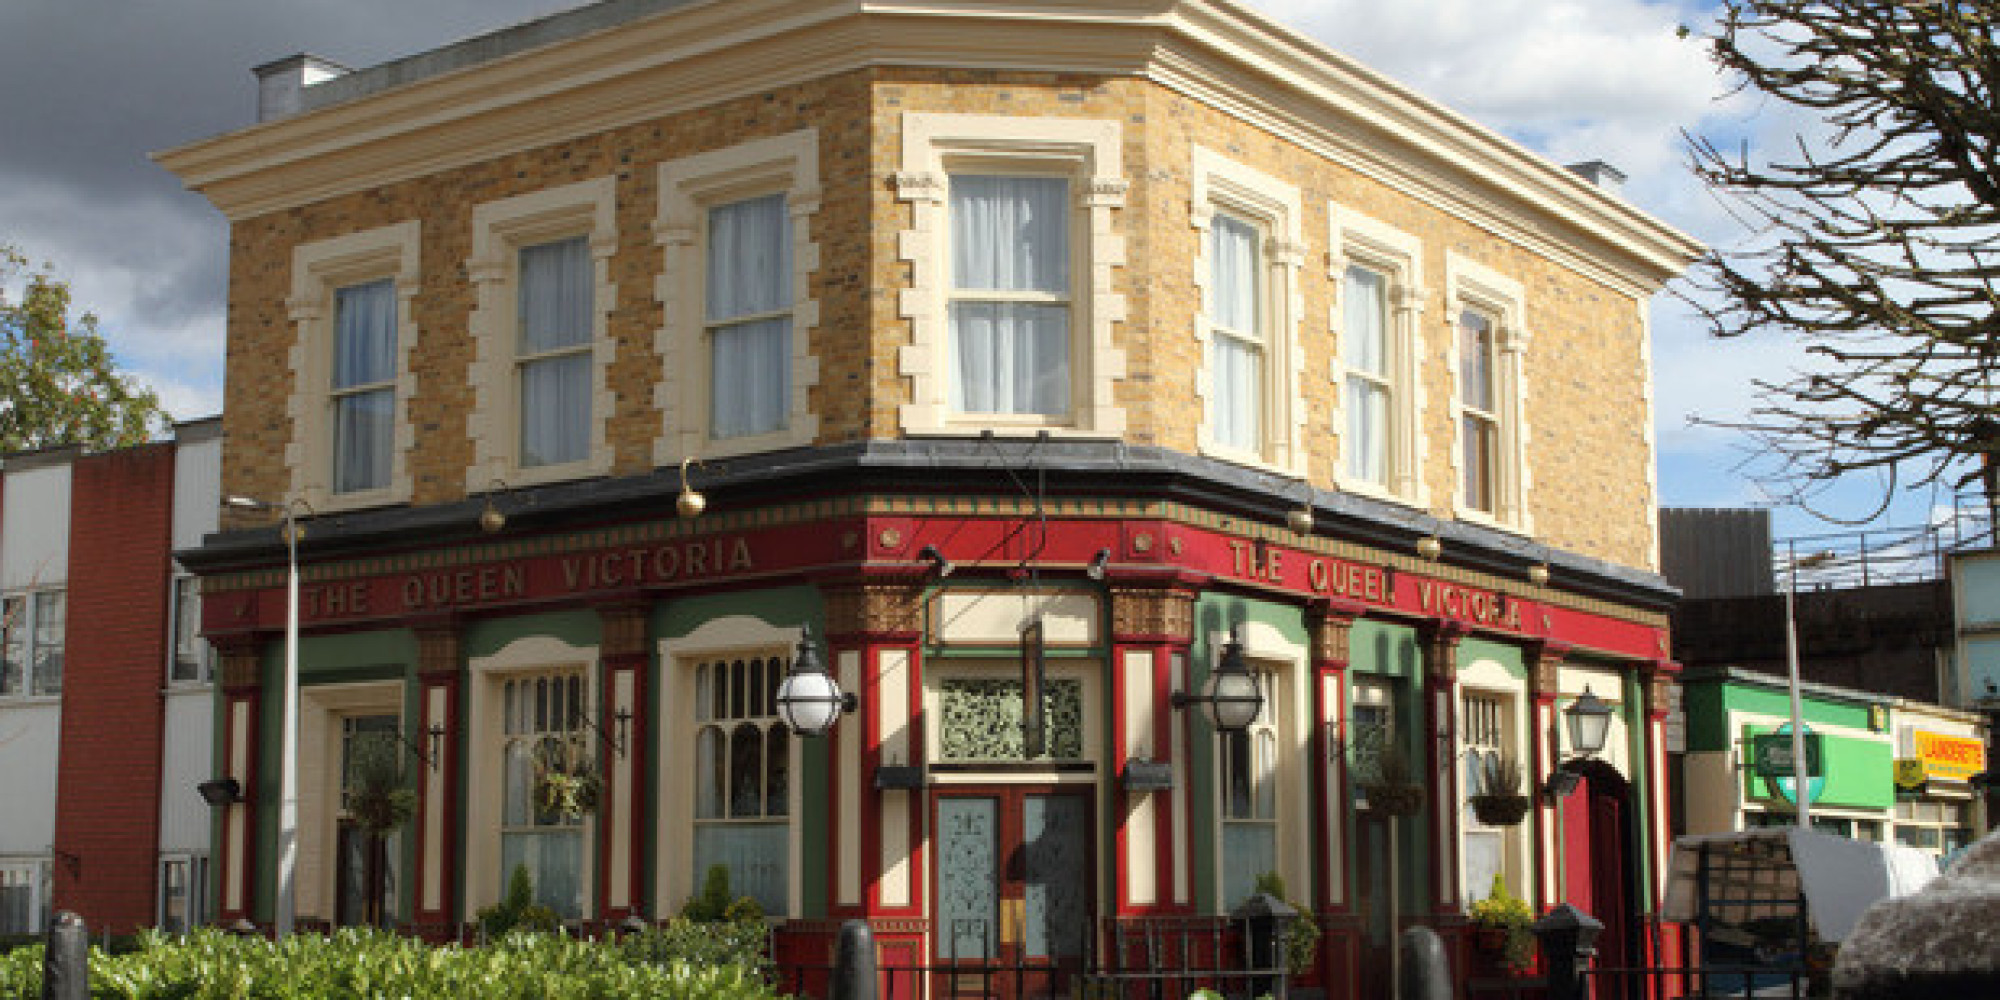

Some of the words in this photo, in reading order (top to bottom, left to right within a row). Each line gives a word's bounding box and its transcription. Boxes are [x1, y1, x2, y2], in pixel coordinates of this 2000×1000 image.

[308, 583, 368, 616] THE
[401, 567, 523, 607] QUEEN
[561, 536, 752, 588] VICTORIA
[1229, 540, 1283, 584] THE
[1309, 559, 1396, 604] QUEEN
[1418, 580, 1522, 630] VICTORA
